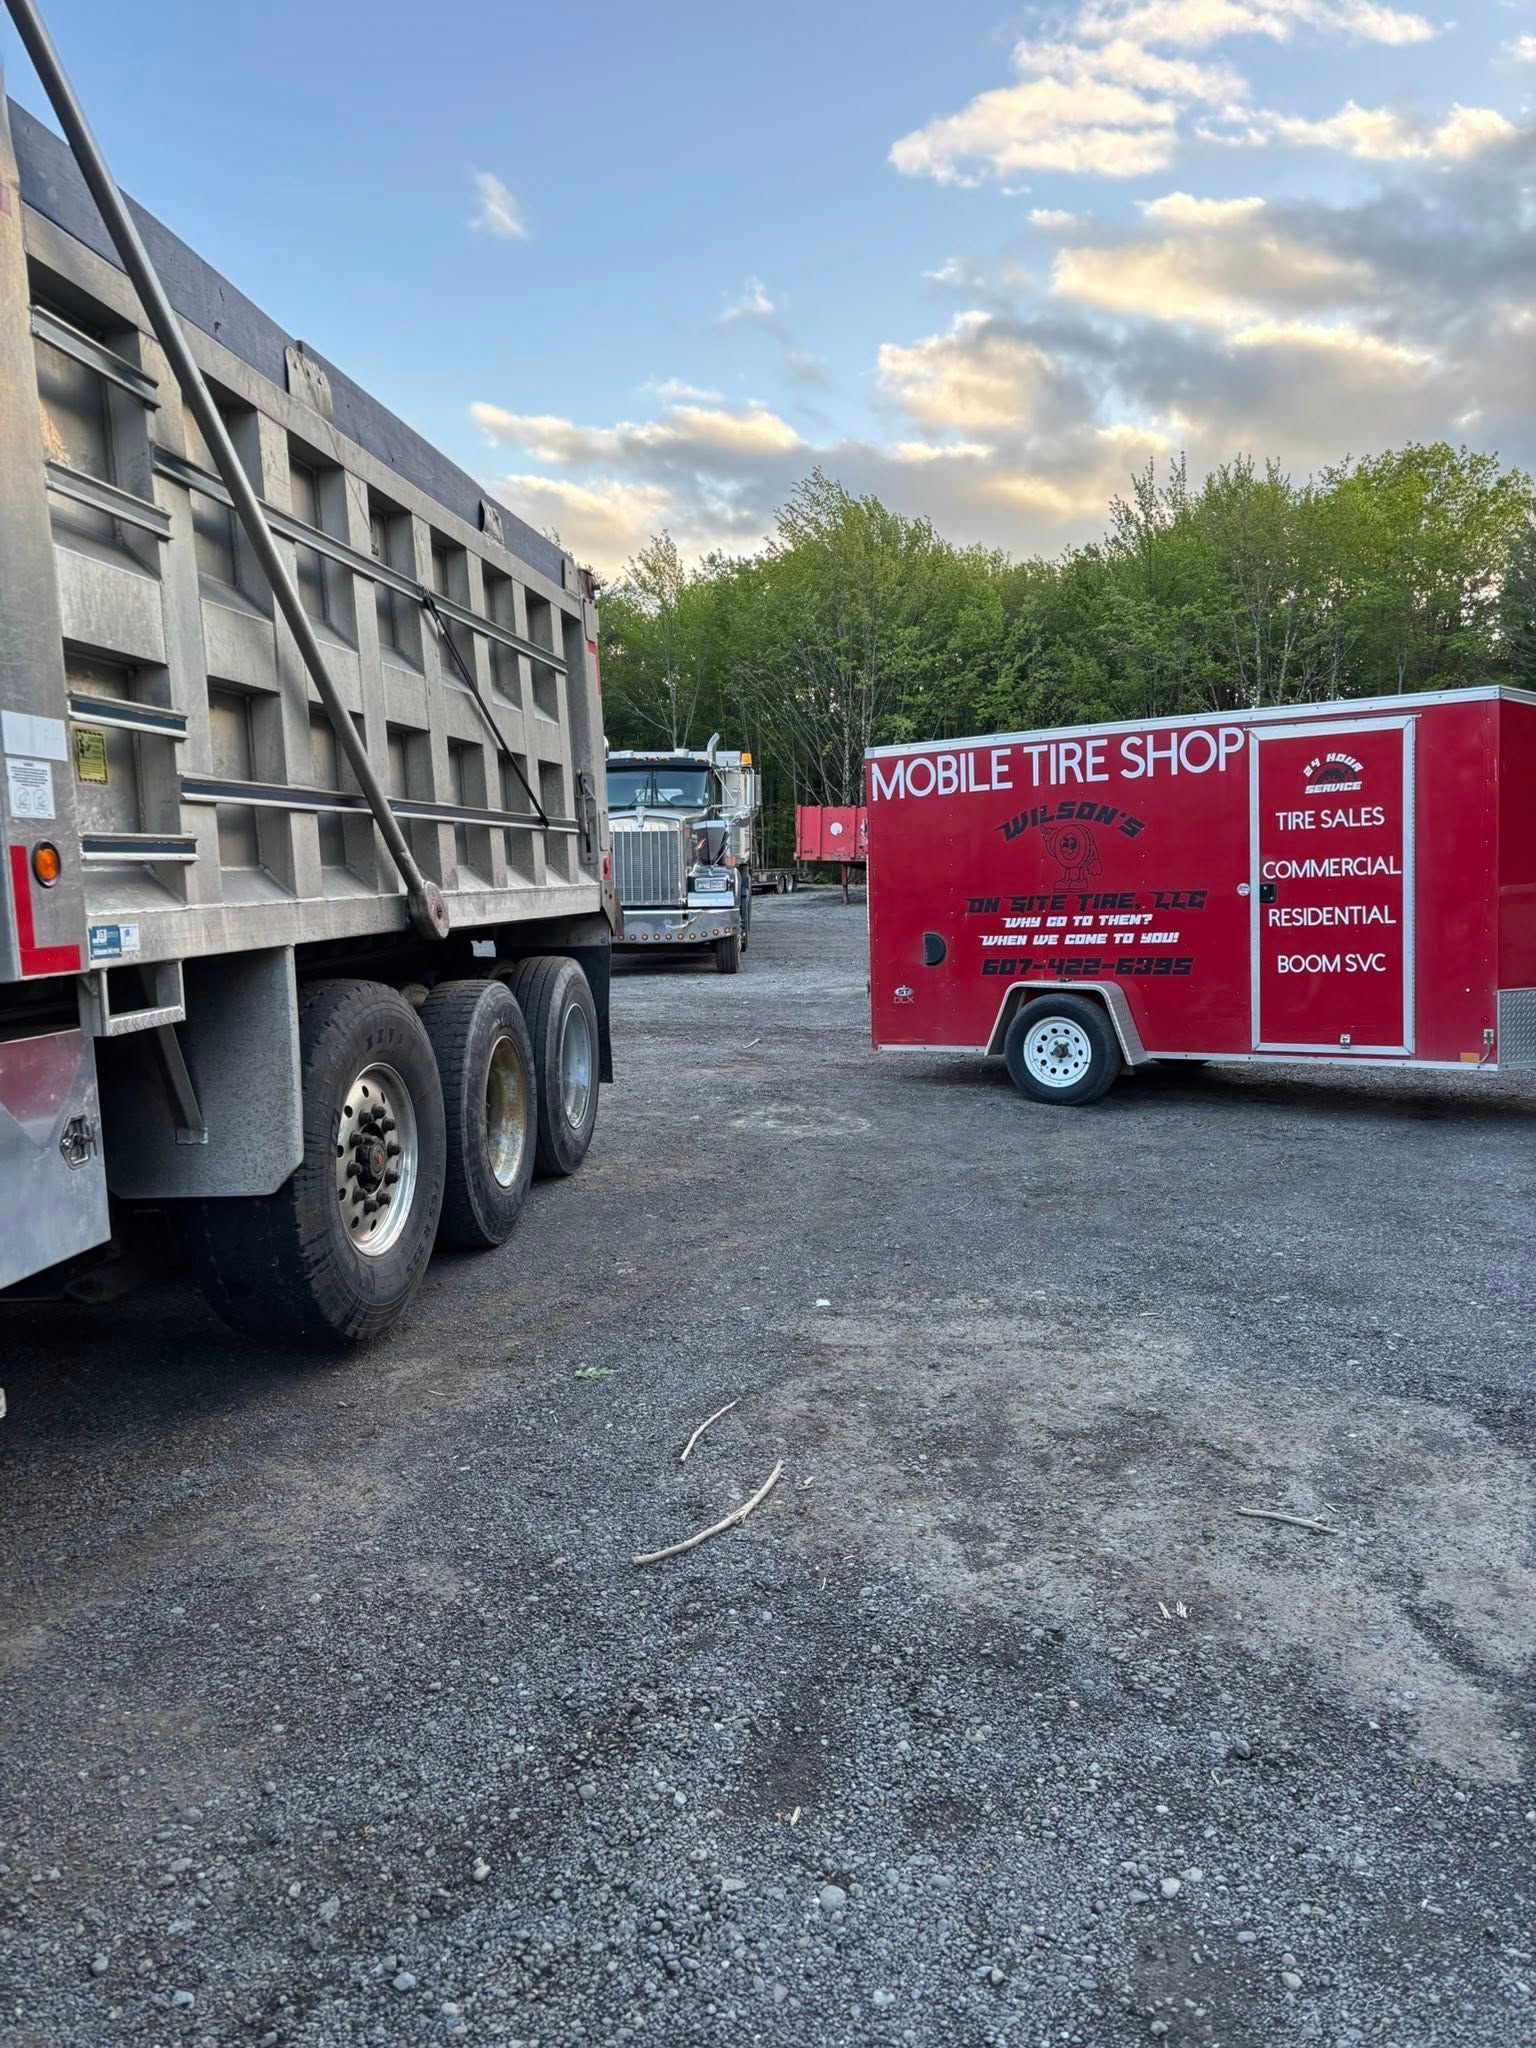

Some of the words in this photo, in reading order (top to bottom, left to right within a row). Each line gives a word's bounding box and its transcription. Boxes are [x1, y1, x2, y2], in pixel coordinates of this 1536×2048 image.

[871, 748, 1013, 801] MOBILE
[1023, 738, 1109, 788] TIRE
[1120, 727, 1245, 780] SHOP
[1326, 752, 1364, 773] HOUR
[1304, 781, 1363, 794] SERVICE
[993, 800, 1146, 841] WILSON'S
[1275, 810, 1316, 831] TIRE
[1320, 806, 1385, 829] SALES
[1262, 856, 1402, 880] COMMERCIAL
[964, 895, 1000, 914] ON
[1003, 893, 1065, 914] SITE
[1150, 890, 1208, 911] LLC
[1001, 916, 1041, 928] WHY
[1046, 916, 1068, 927] GO
[1073, 916, 1092, 926] TO
[1099, 913, 1153, 926] THEM?
[1268, 905, 1396, 927] RESIDENTIAL
[978, 935, 1026, 946] WHEN
[1032, 935, 1058, 945] WE
[1064, 934, 1108, 945] COME
[1113, 933, 1134, 944] TO
[1140, 932, 1180, 944] YOU!
[981, 957, 1194, 976] 607-422-6395
[1277, 954, 1341, 973] BOOM
[1345, 953, 1386, 972] SVC
